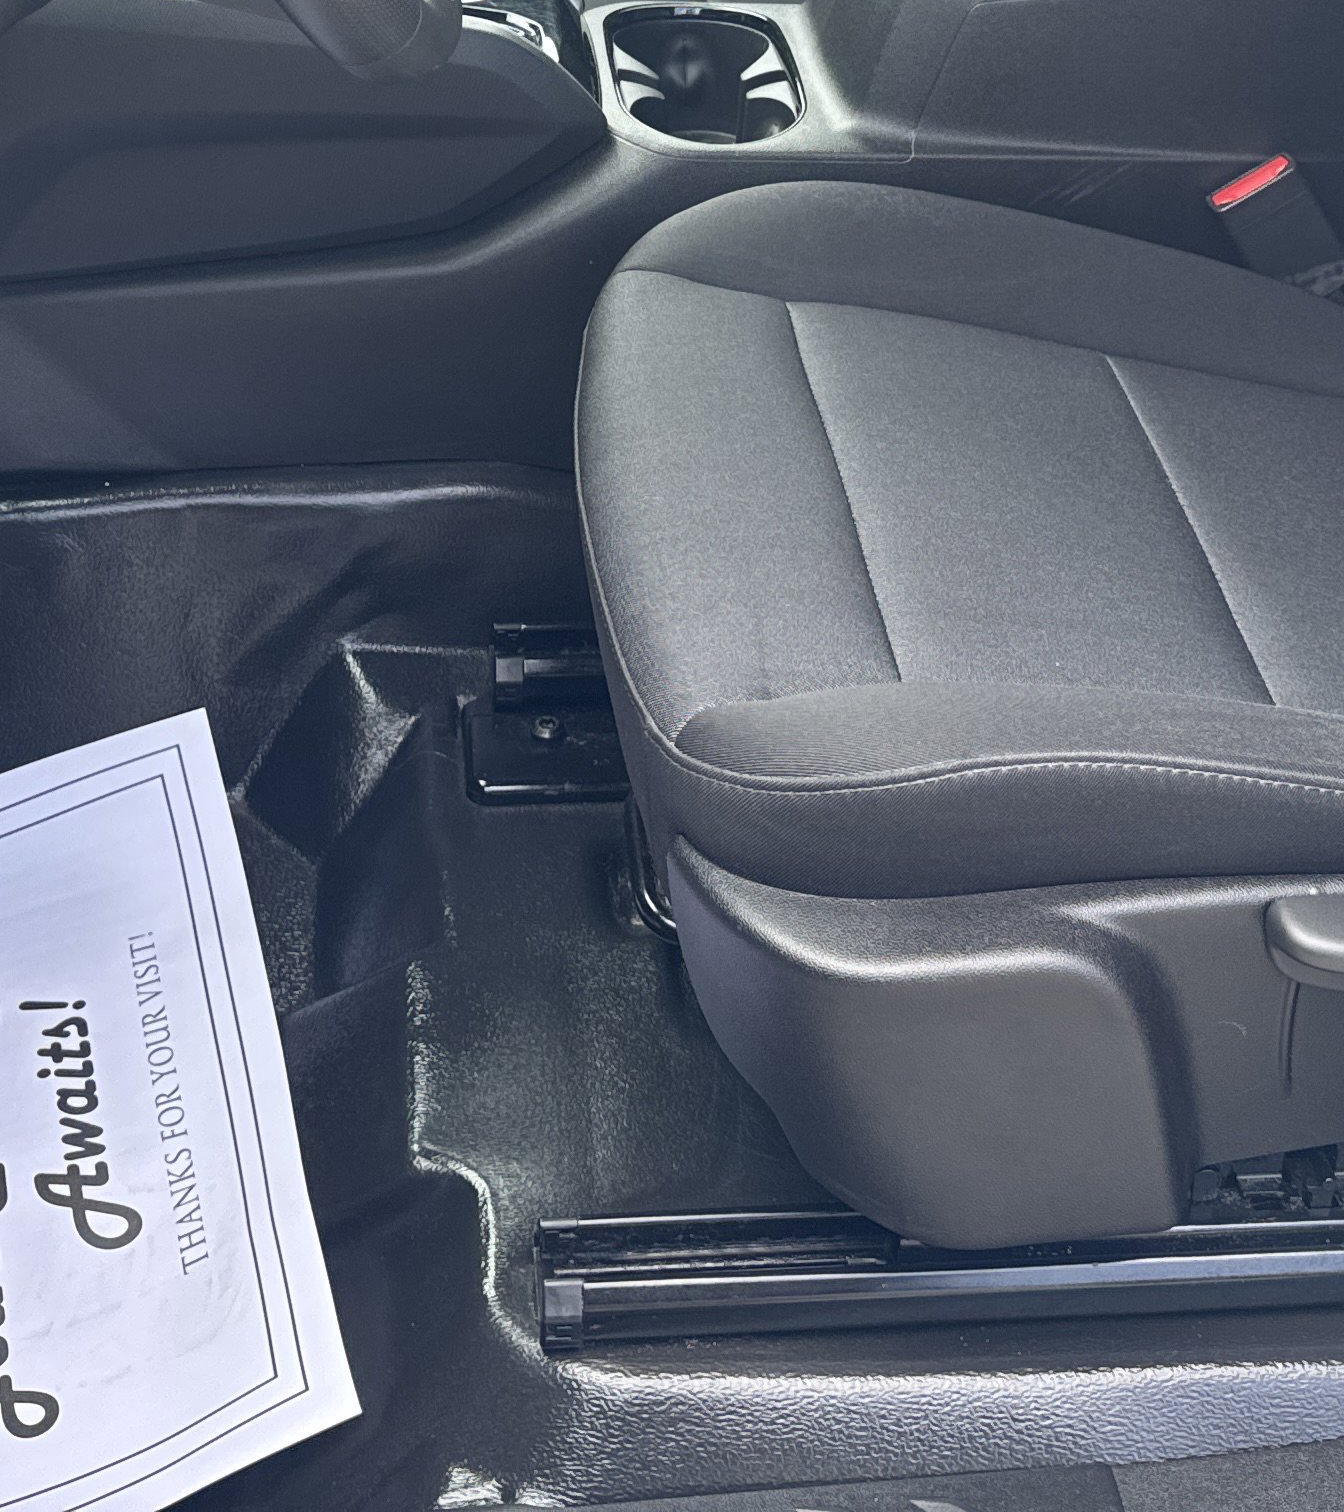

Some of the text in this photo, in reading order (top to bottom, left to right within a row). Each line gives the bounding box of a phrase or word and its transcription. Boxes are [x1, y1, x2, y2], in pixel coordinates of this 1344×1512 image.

[19, 1000, 143, 1250] Awaits!
[128, 930, 210, 1276] THANKS FOR YOUR VISIT!
